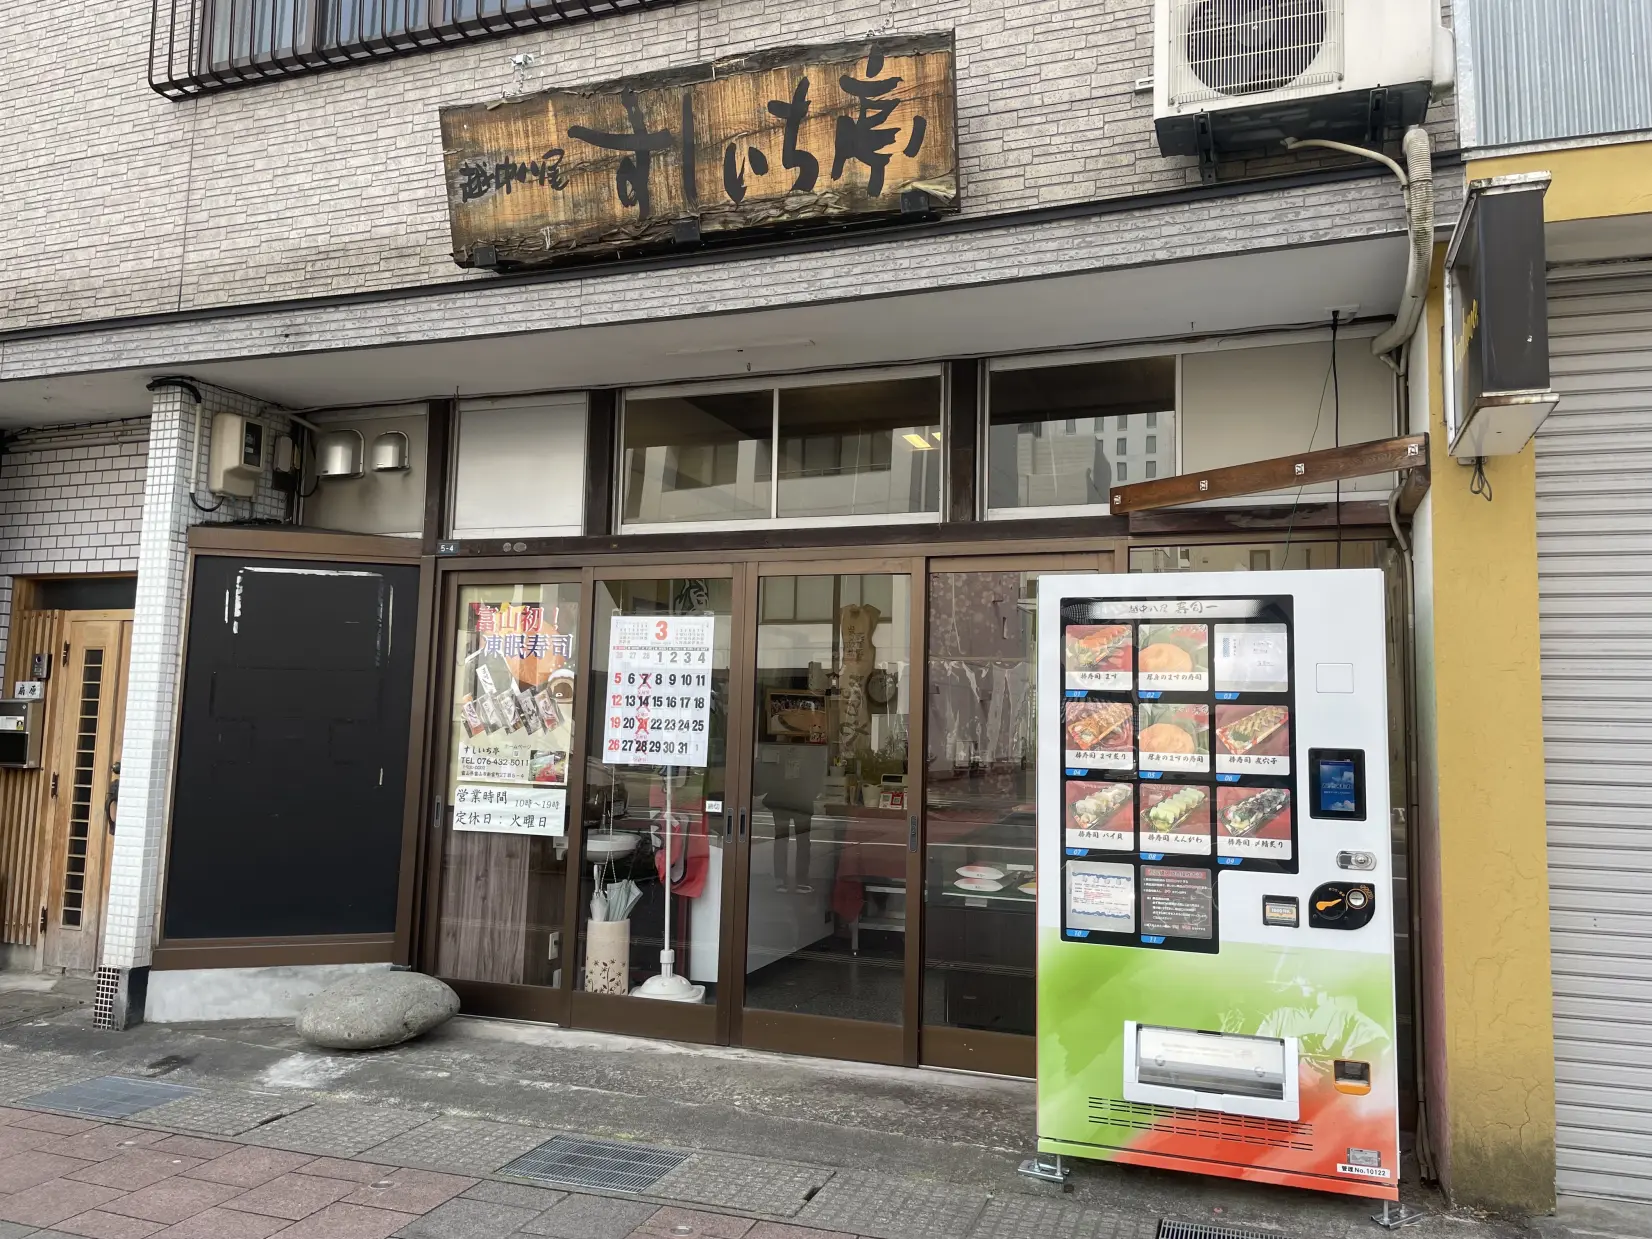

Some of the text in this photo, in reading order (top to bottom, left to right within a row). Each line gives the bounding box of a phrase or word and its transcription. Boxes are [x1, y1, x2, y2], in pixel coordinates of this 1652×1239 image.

[440, 544, 454, 552] 5-4
[655, 620, 668, 641] 3
[483, 633, 574, 660] 凍眠寿司
[657, 651, 663, 663] 1
[670, 651, 678, 663] 2
[684, 652, 692, 663] 3
[698, 652, 705, 664] 4
[614, 672, 705, 686] 5 6 7 8 9 10 11
[612, 694, 704, 709] 12 13 14 15 16 17 18
[610, 716, 704, 732] 19 20 21 22 23 24 25
[464, 745, 500, 756] すしいち亭
[608, 739, 619, 751] 26
[622, 740, 633, 751] 27
[635, 740, 647, 753] 28
[649, 741, 661, 753] 29
[663, 741, 674, 754] 30
[678, 742, 688, 754] 31
[461, 756, 475, 765] TEL
[456, 789, 508, 805] 営業時間
